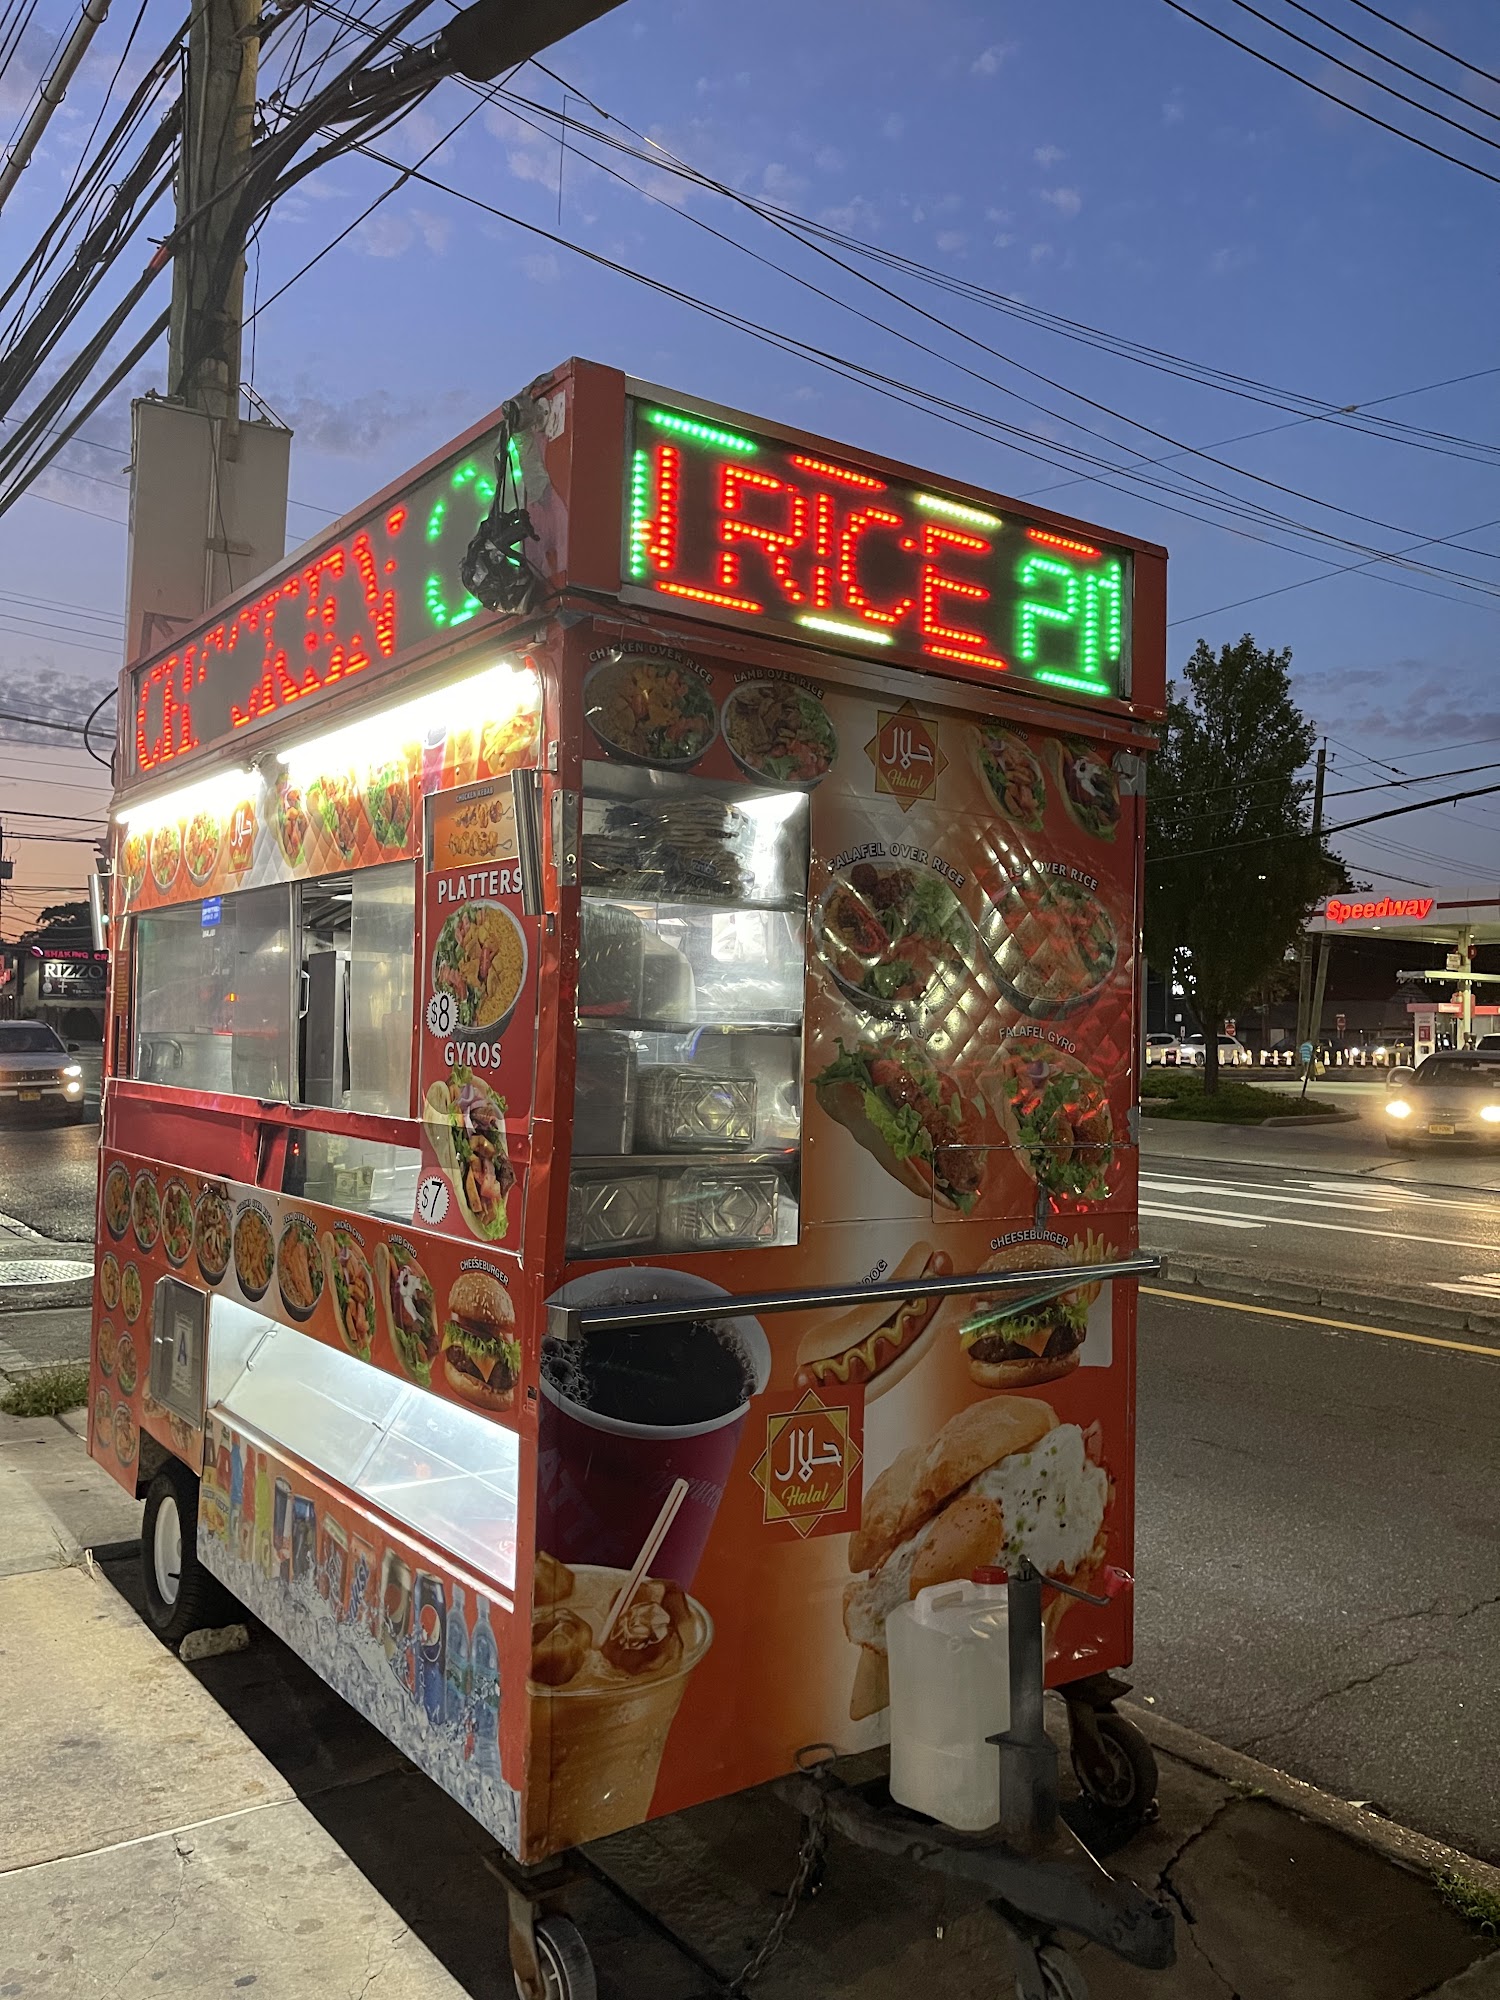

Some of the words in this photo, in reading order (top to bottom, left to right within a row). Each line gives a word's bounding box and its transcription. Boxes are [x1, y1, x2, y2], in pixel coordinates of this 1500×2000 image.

[719, 462, 990, 648] RICE
[588, 641, 645, 664] CHICKEN
[650, 645, 684, 665] OVER
[686, 659, 714, 685] RICE
[733, 669, 764, 684] LAMB
[766, 669, 797, 685] OVER
[799, 678, 825, 699] RICE
[886, 769, 925, 790] Halal
[827, 842, 886, 872] FALAFEL
[889, 842, 930, 864] OVER
[931, 858, 967, 889] RICE
[1032, 859, 1067, 877] OVER
[1069, 868, 1099, 892] RICE
[438, 867, 523, 904] PLATTERS
[1326, 897, 1434, 925] Speedway
[44, 950, 89, 960] SHAKING
[43, 962, 104, 979] RIZZO
[430, 994, 450, 1033] $8
[1000, 1025, 1046, 1040] FALAFEL
[1047, 1031, 1077, 1055] GYRO
[444, 1041, 503, 1070] GYROS
[421, 1180, 443, 1220] $7
[333, 1220, 353, 1233] CHICKEN
[989, 1229, 1070, 1250] CHEESEBURGER
[387, 1233, 404, 1246] LAMB
[402, 1239, 418, 1259] GYRO
[459, 1259, 509, 1287] CHEESEBURGER
[775, 1428, 843, 1482] حلال
[781, 1482, 830, 1507] Halal
